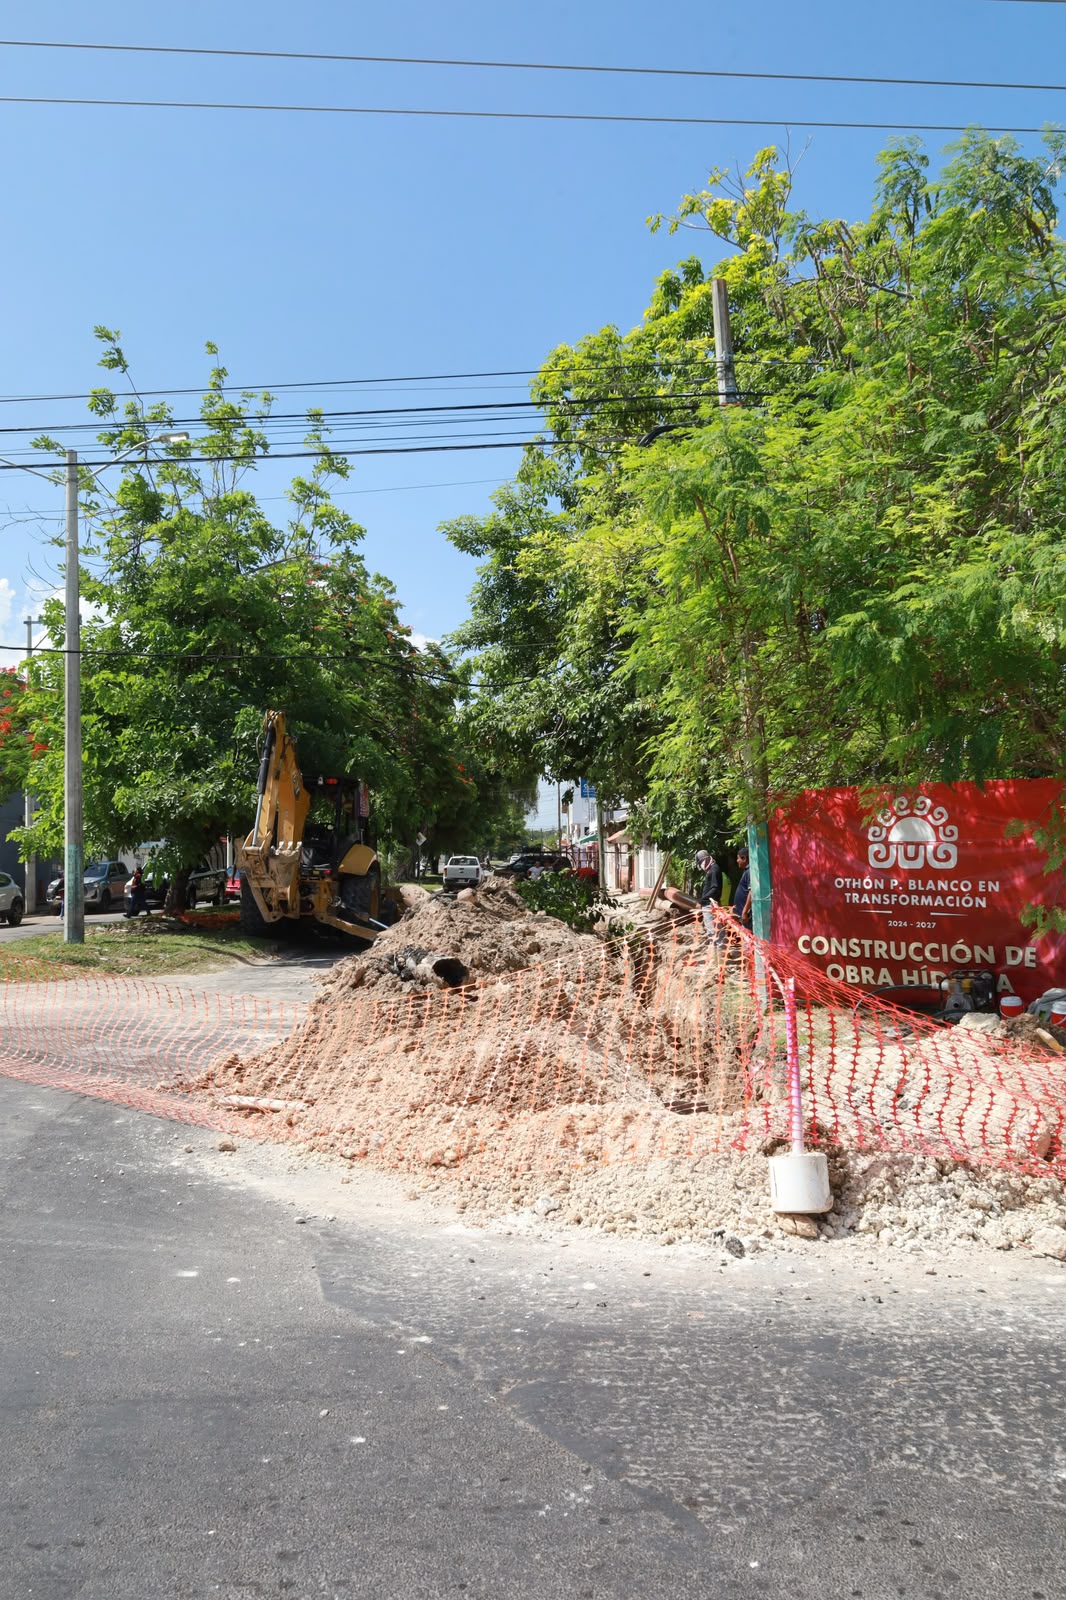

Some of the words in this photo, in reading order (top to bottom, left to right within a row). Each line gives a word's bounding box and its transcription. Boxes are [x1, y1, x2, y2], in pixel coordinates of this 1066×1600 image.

[834, 875, 884, 890] OTHÓN
[890, 879, 903, 890] P.
[908, 879, 972, 892] BLANCO
[978, 880, 1000, 892] EN
[844, 892, 987, 908] TRANSFORMACIÓN
[916, 921, 937, 929] 2027
[797, 935, 995, 964] CONSTRUCCIÓN
[1005, 946, 1037, 968] DE
[826, 963, 895, 986] OBRA
[901, 965, 1015, 994] HÍDA
